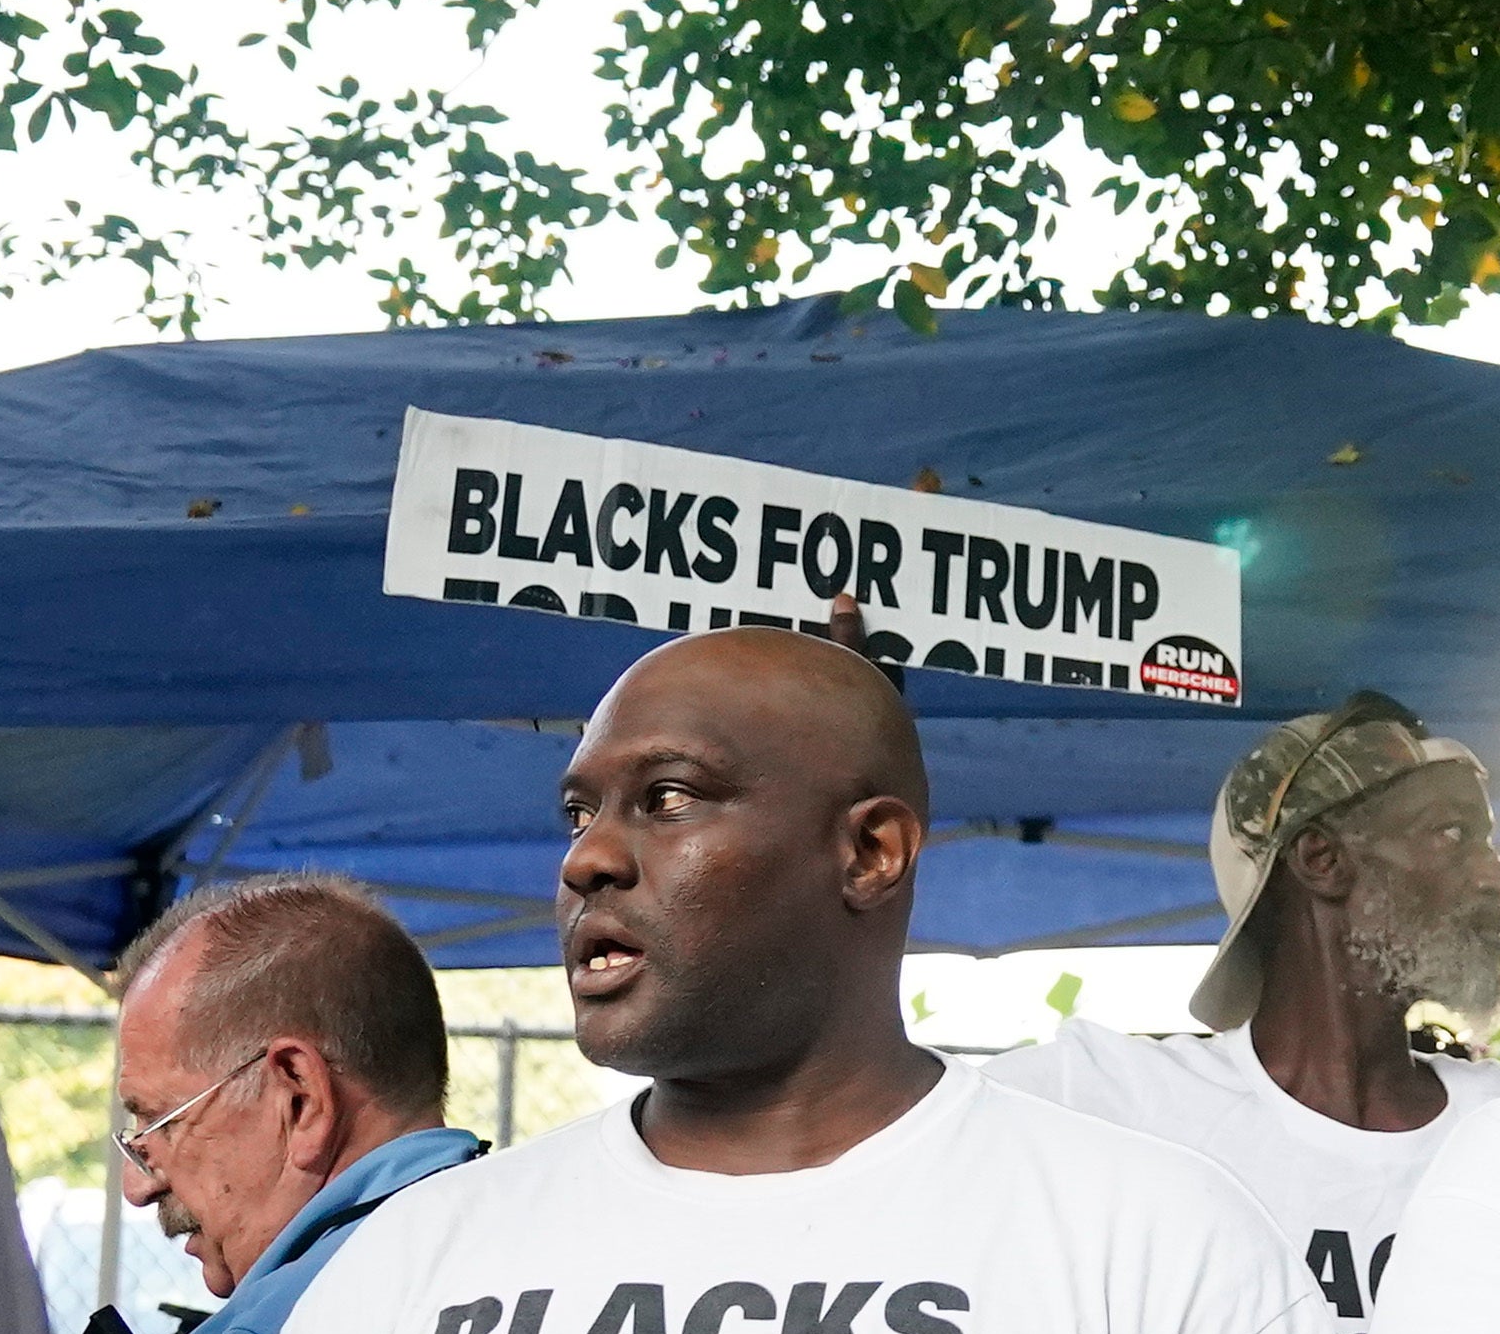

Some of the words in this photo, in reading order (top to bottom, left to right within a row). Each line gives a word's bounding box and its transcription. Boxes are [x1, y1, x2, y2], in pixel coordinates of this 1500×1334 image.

[447, 467, 740, 584] BLACKS
[757, 504, 903, 608] FOR
[922, 527, 1160, 642] TRUMP
[1156, 643, 1224, 674] RUN
[1143, 667, 1236, 694] HERSCHEL
